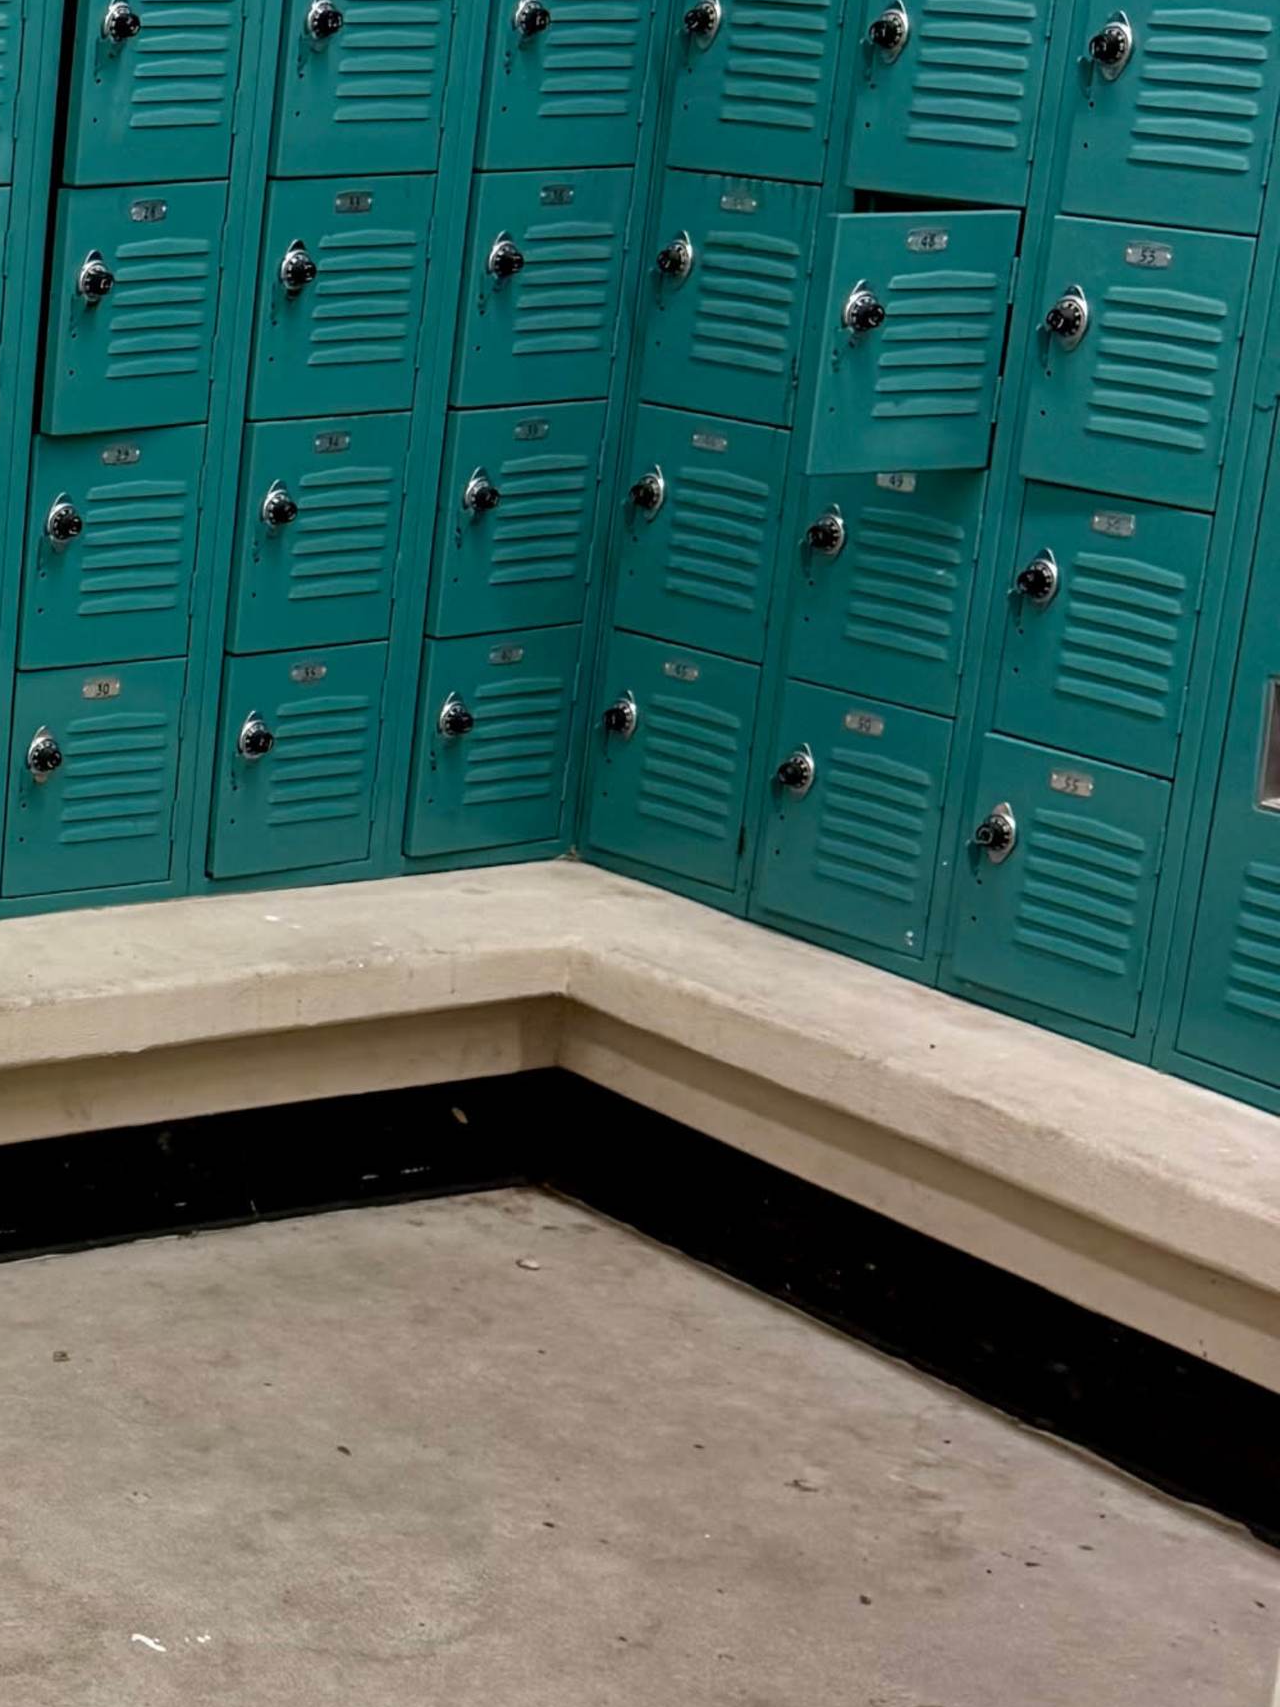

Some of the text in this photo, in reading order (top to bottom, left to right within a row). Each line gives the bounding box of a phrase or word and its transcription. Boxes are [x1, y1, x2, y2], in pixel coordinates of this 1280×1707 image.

[1139, 247, 1155, 264] 53
[889, 474, 903, 488] 49
[95, 683, 110, 696] 30
[1064, 776, 1080, 792] 55
